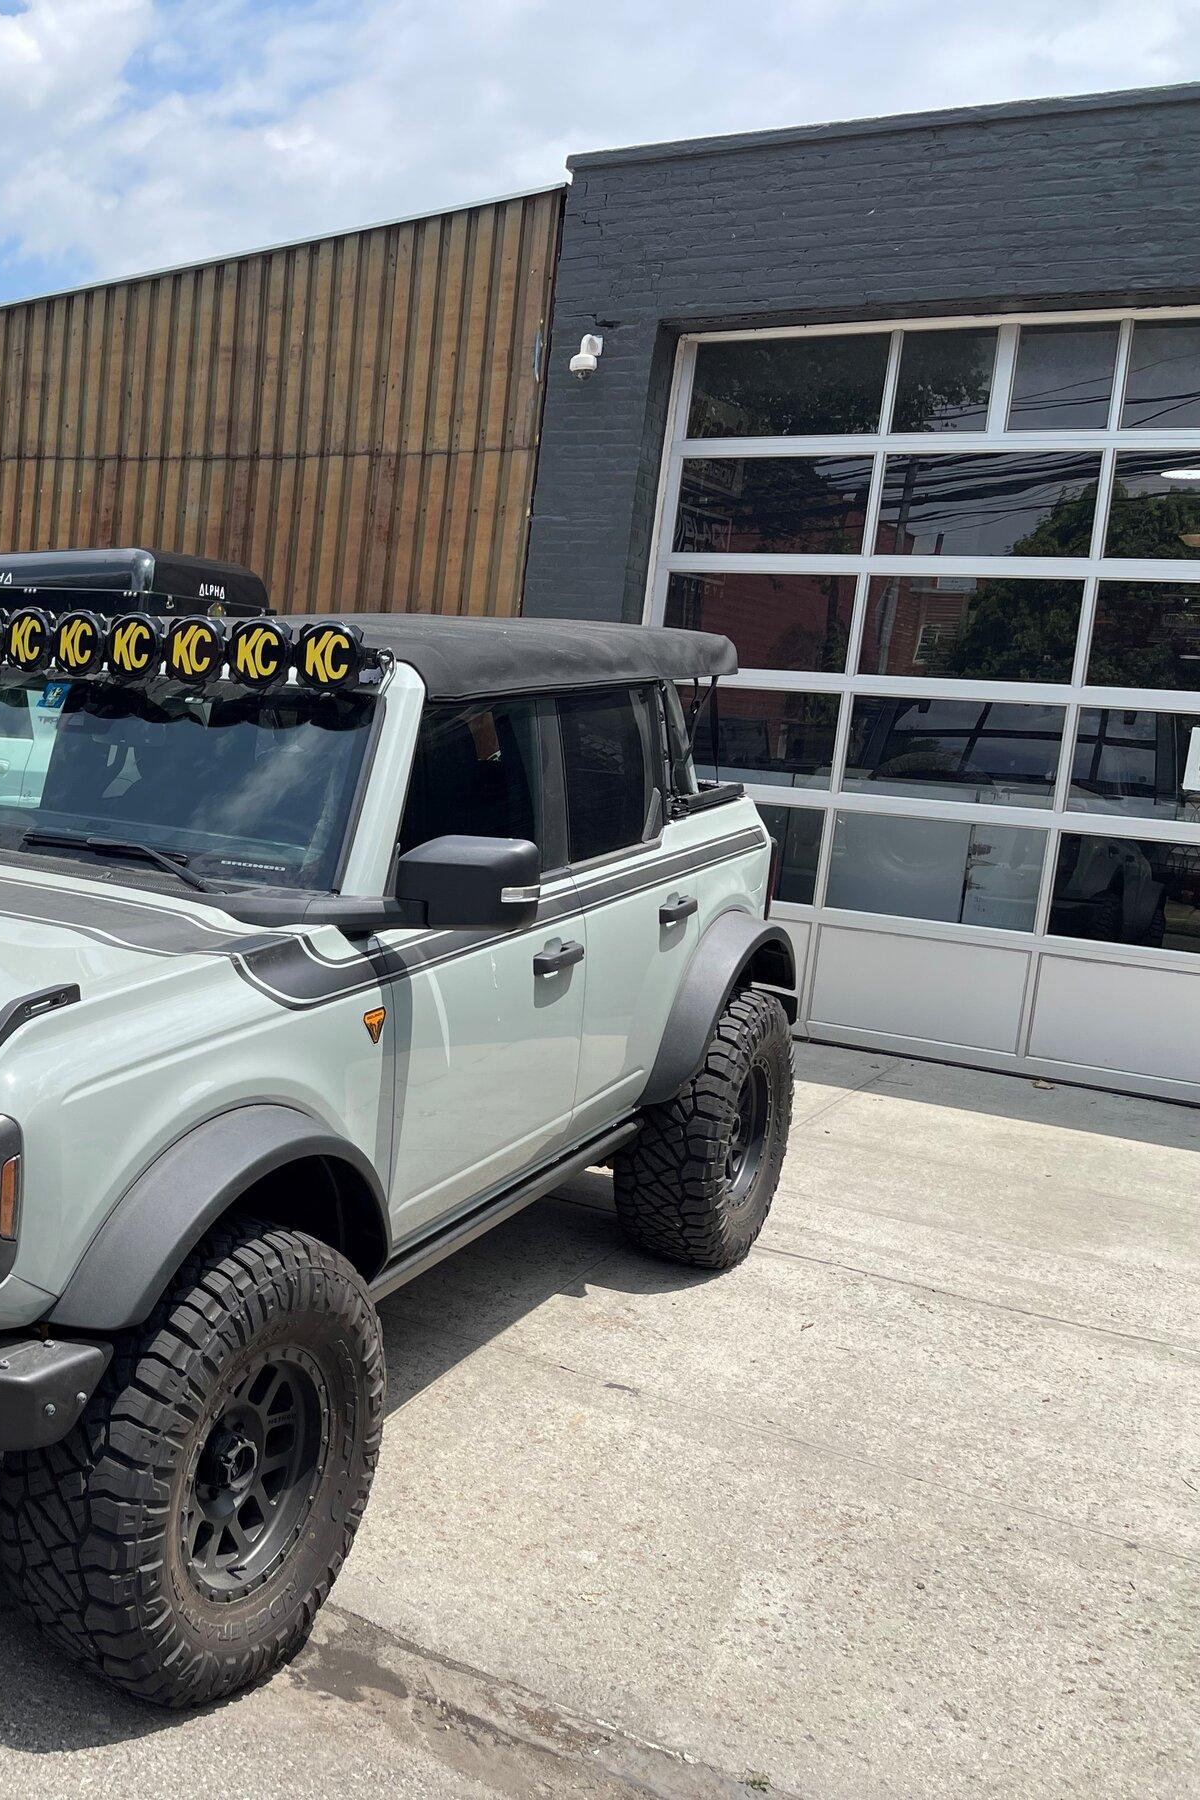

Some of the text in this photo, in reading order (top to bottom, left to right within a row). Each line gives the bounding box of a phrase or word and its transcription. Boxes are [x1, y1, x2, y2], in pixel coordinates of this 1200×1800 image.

[198, 582, 226, 600] ALPHA
[10, 616, 41, 663] KC
[59, 619, 93, 667] KC
[113, 622, 150, 671] KC
[172, 624, 212, 676] KC
[236, 627, 278, 679] KC
[305, 630, 349, 683] KC
